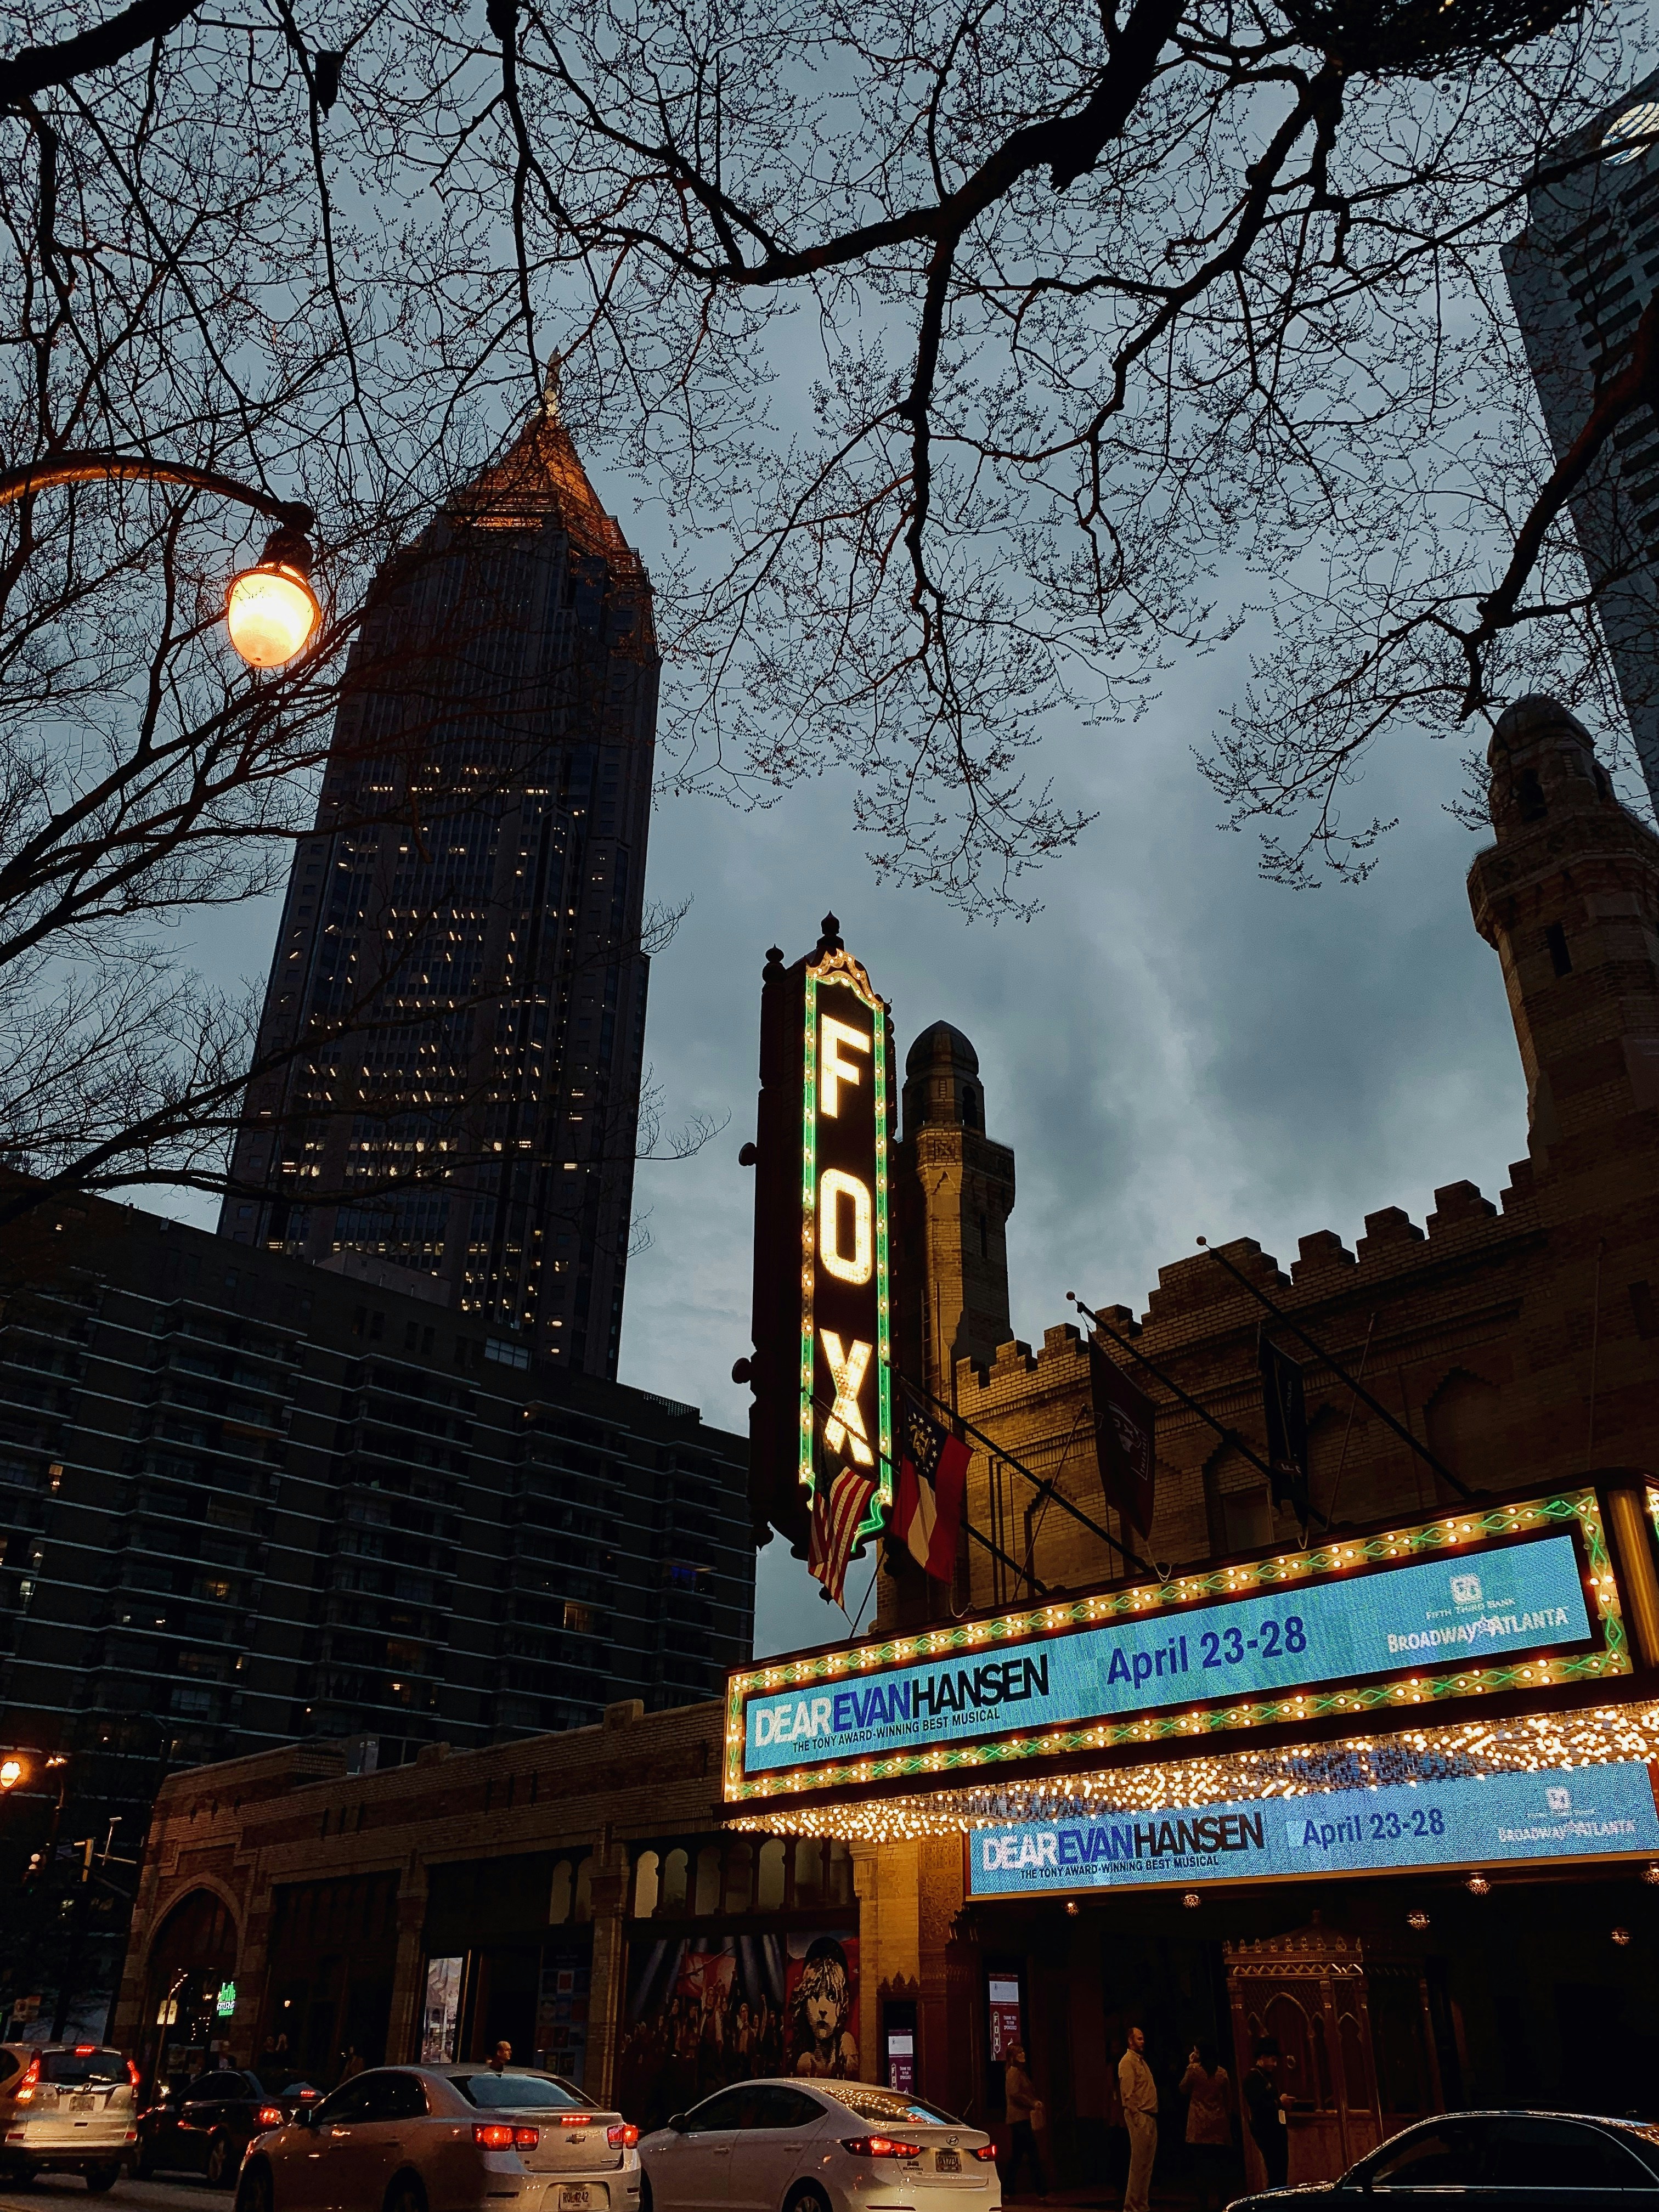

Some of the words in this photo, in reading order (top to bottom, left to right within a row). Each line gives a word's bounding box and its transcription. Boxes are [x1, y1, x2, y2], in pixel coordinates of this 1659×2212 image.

[818, 1014, 873, 1466] FOX
[1107, 1634, 1189, 1690] April
[1200, 1616, 1307, 1669] 23-28
[1387, 1620, 1478, 1654] BROADWAY
[1487, 1607, 1569, 1638] ATLANTA
[793, 1740, 810, 1753] THE
[813, 1735, 837, 1750] TONY
[838, 1721, 919, 1746] AWARD-WINNING
[922, 1716, 949, 1731] BEST
[952, 1707, 1000, 1726] MUSICAL
[1303, 1815, 1362, 1850] April
[1371, 1808, 1446, 1838] 23-28
[1020, 1870, 1037, 1880] THE
[1040, 1867, 1063, 1878] TONY
[1146, 1858, 1171, 1870] BEST
[1173, 1855, 1220, 1869] MUSICAL
